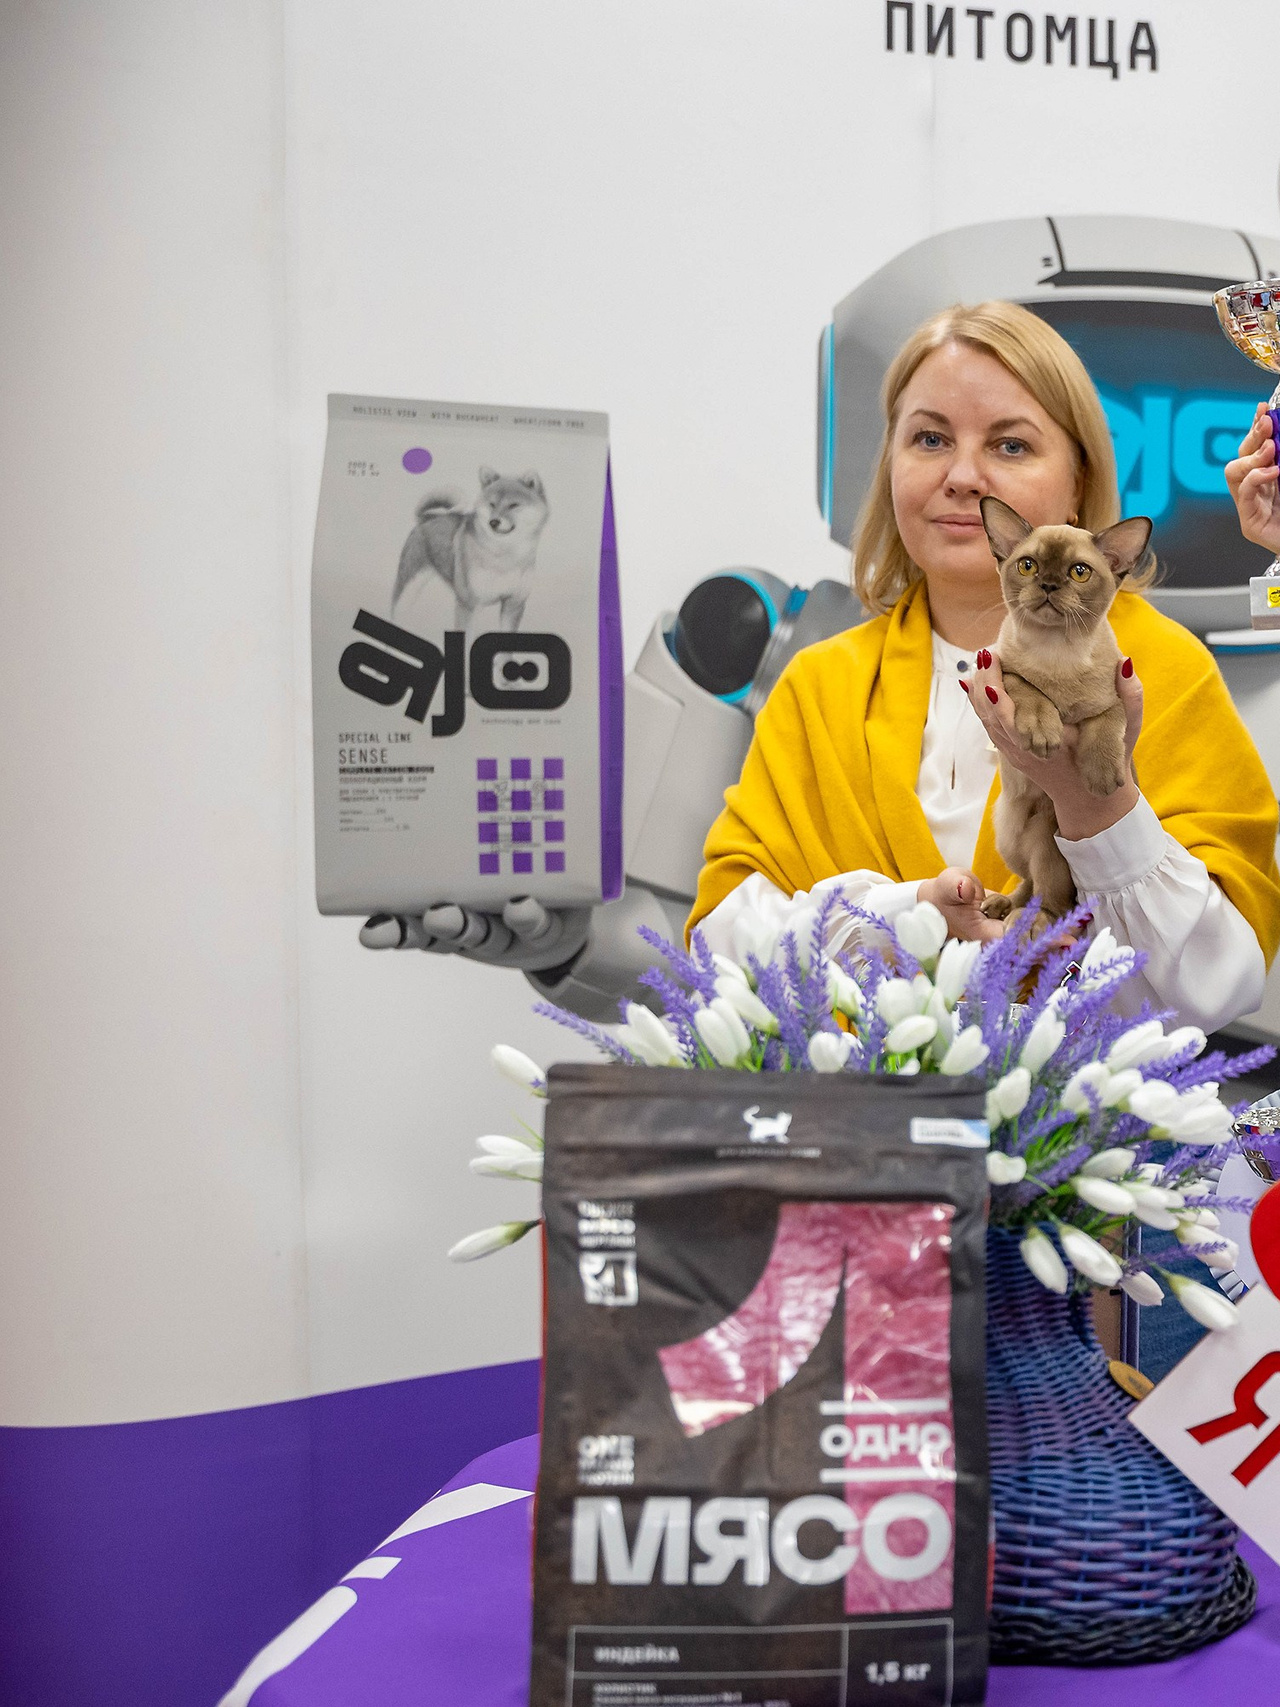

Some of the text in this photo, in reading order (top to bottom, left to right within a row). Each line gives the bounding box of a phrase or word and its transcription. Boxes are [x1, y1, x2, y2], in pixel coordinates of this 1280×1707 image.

[886, 0, 1158, 80] ПИТОМЦА
[339, 732, 412, 744] SPECIAL LINE
[339, 747, 388, 765] SENSE
[820, 1422, 953, 1462] ОДНО
[571, 1492, 953, 1587] МЯСО
[594, 1644, 680, 1665] ИНДЕЙКА
[865, 1662, 931, 1687] 1,5 кг
